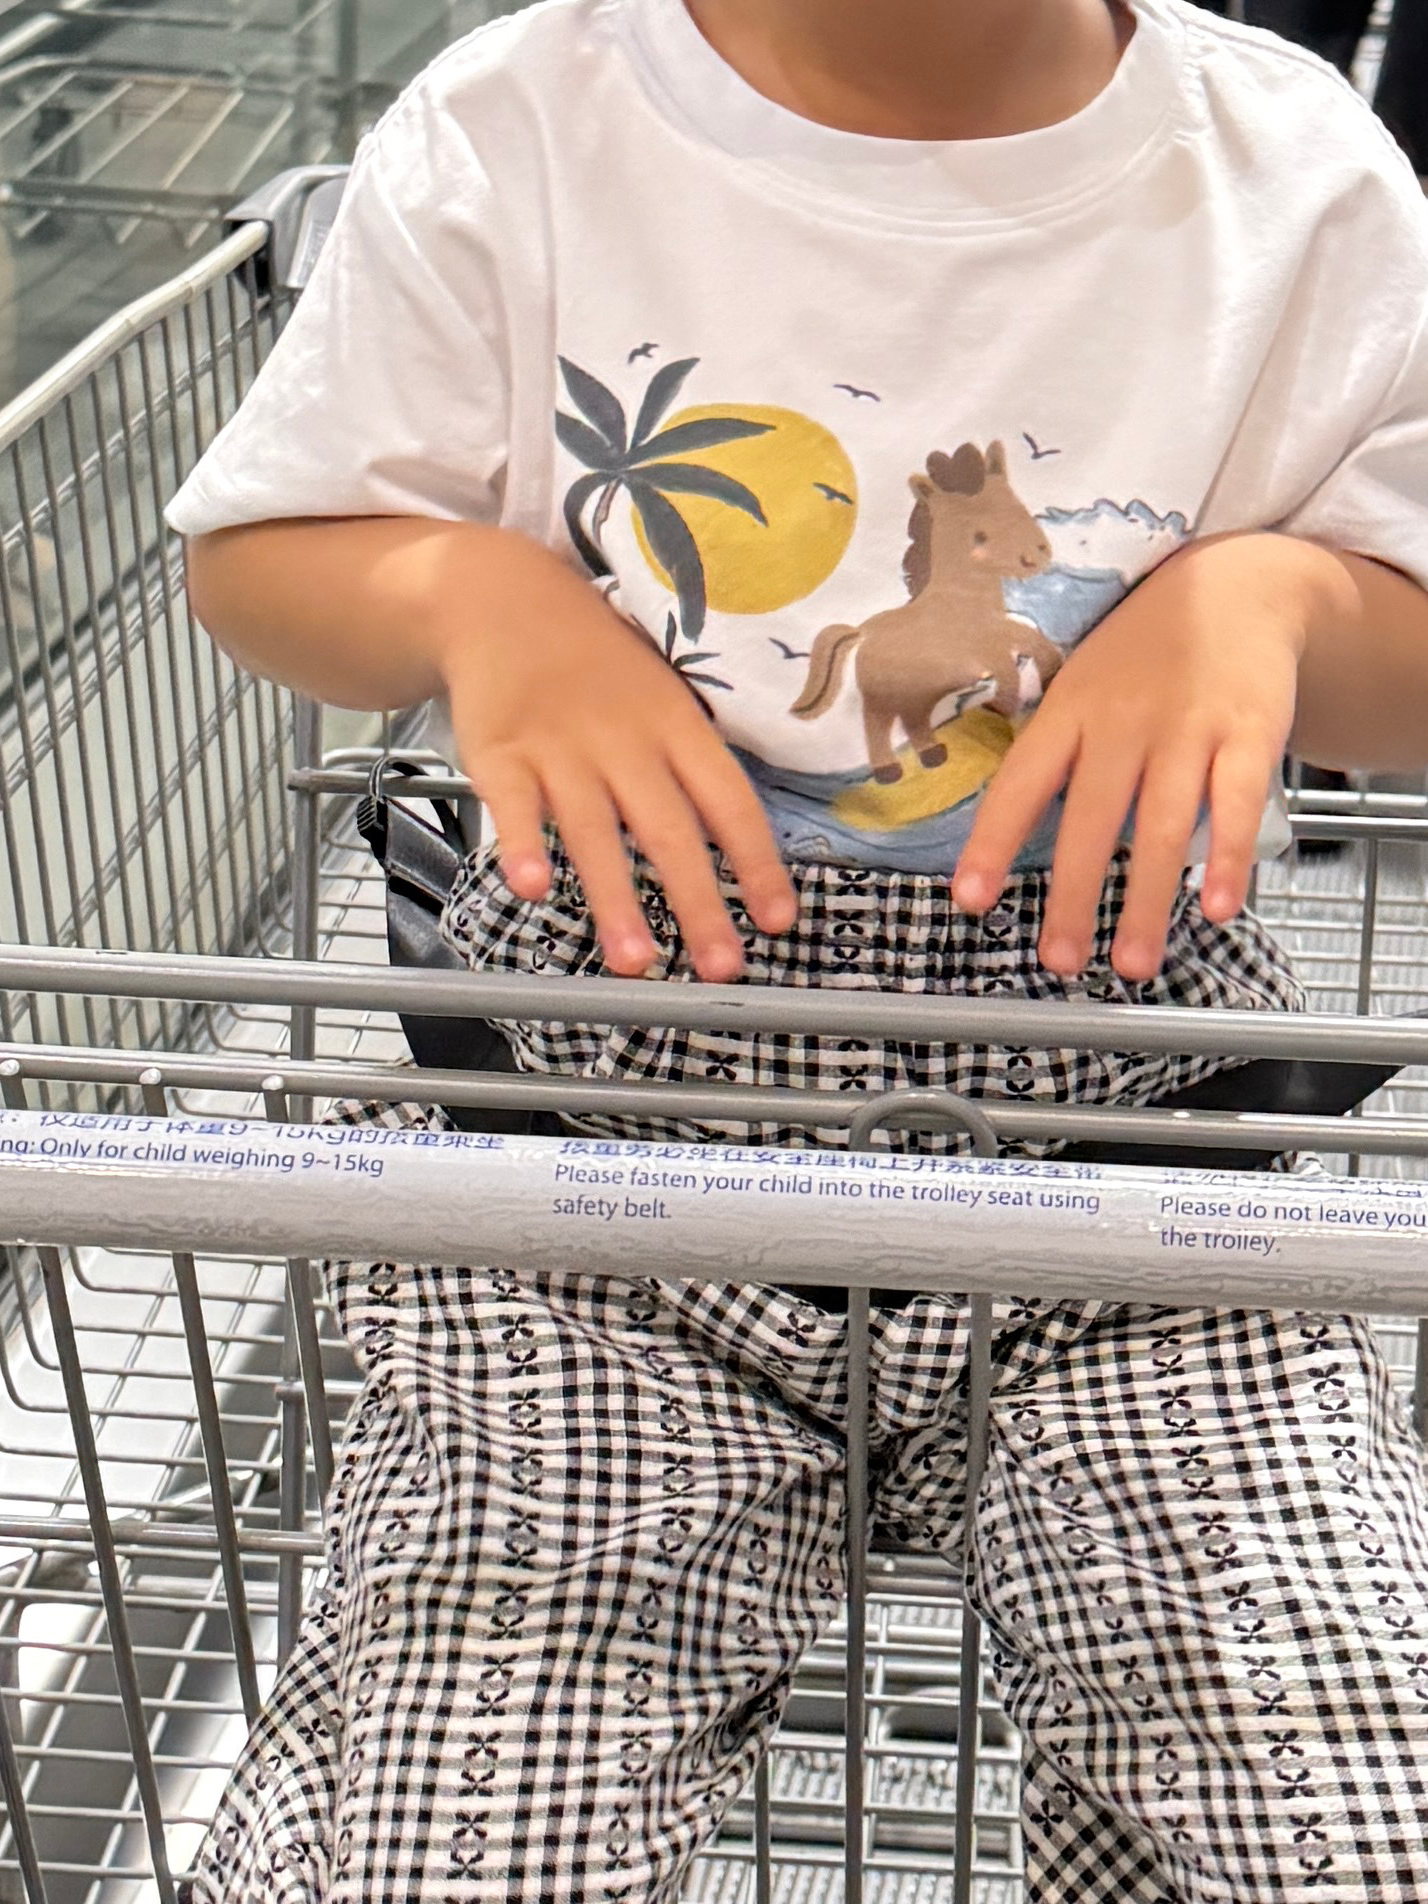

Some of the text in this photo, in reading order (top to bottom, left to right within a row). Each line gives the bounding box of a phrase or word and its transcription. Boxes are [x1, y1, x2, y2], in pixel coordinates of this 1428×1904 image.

[40, 1138, 92, 1159] Only
[97, 1140, 128, 1159] for
[133, 1142, 186, 1163] child
[193, 1145, 295, 1172] weighing
[302, 1152, 384, 1177] 9~15kg
[555, 1163, 1100, 1215] Please fasten your child into the trolley seat using
[552, 1195, 671, 1221] safety belt.
[1160, 1196, 1231, 1217] Please
[1238, 1201, 1268, 1219] do
[1274, 1206, 1312, 1223] not
[1319, 1205, 1379, 1226] leave
[1160, 1225, 1198, 1247] the
